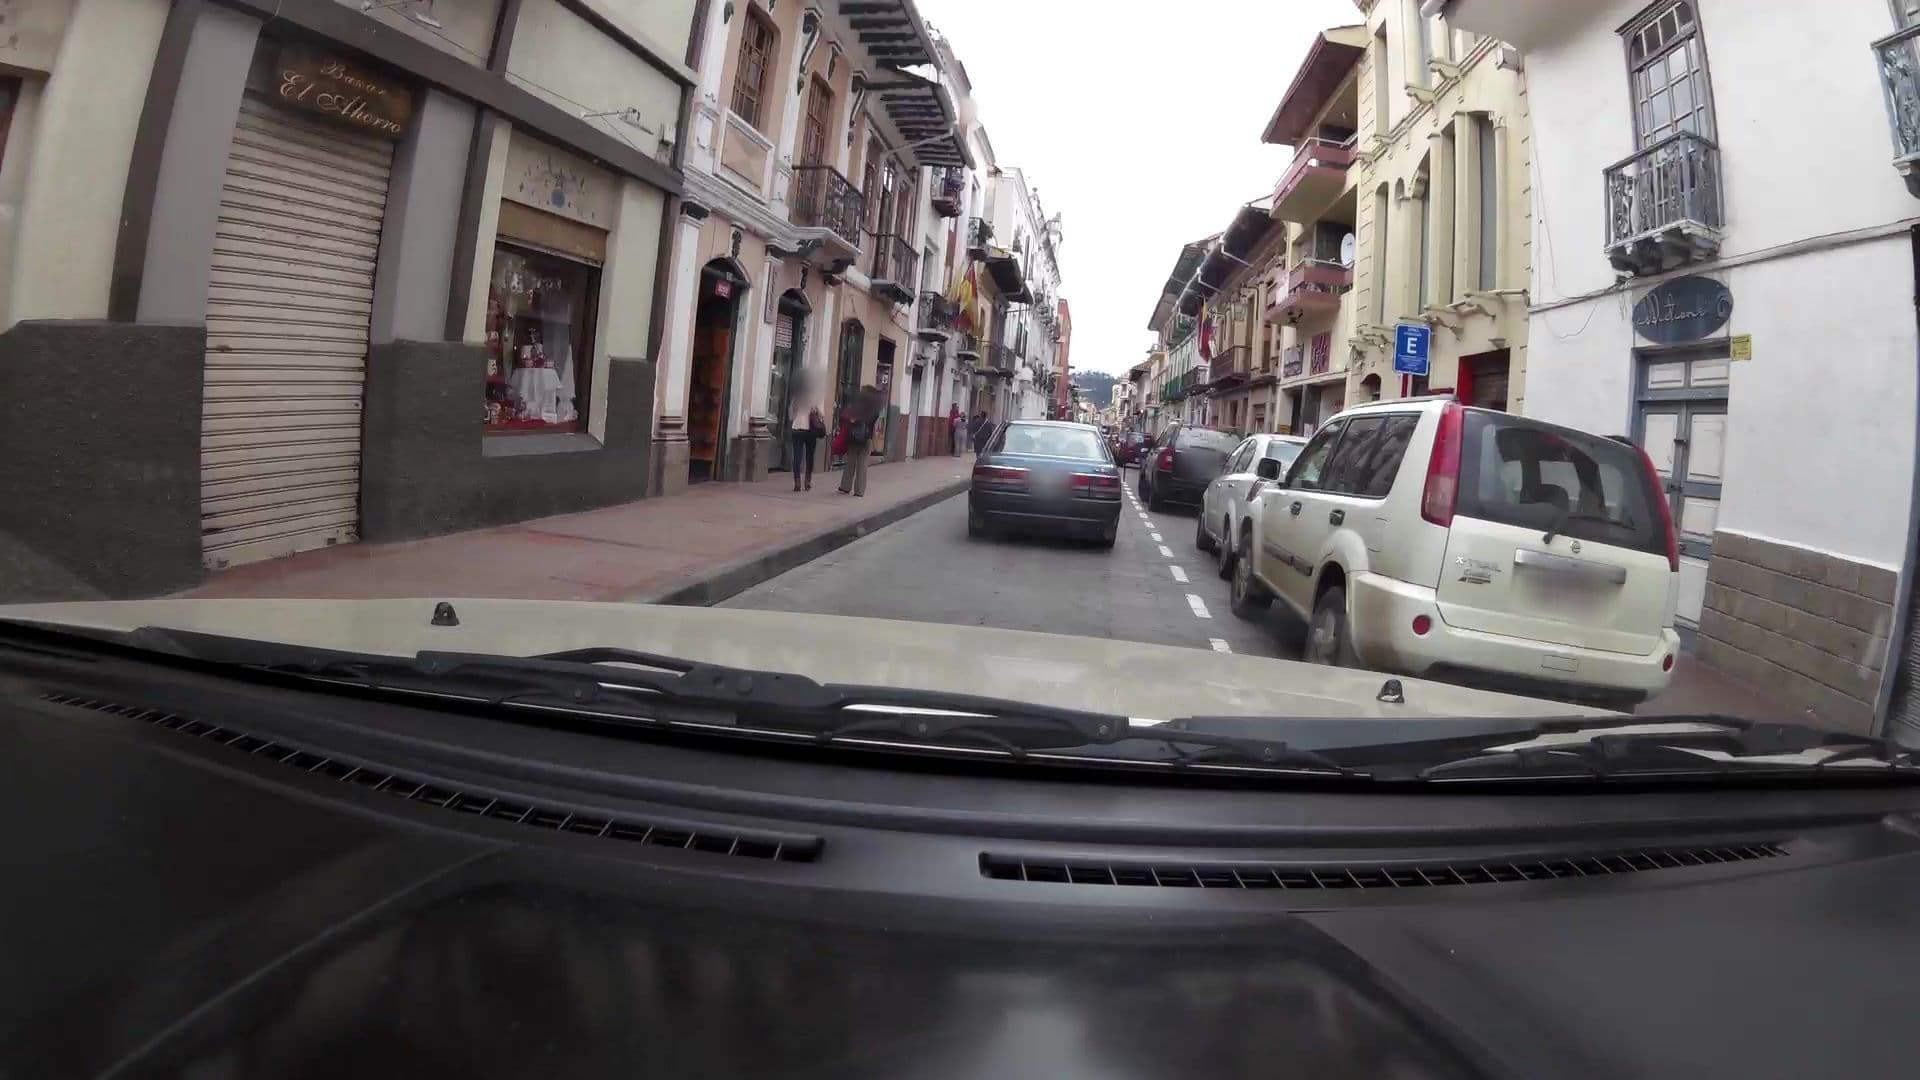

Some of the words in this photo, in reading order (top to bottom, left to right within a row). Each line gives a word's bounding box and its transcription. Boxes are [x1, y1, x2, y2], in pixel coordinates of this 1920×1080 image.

[280, 70, 315, 101] El
[317, 93, 401, 133] Ahorro
[1406, 337, 1418, 354] E
[1455, 555, 1503, 573] X-TL
